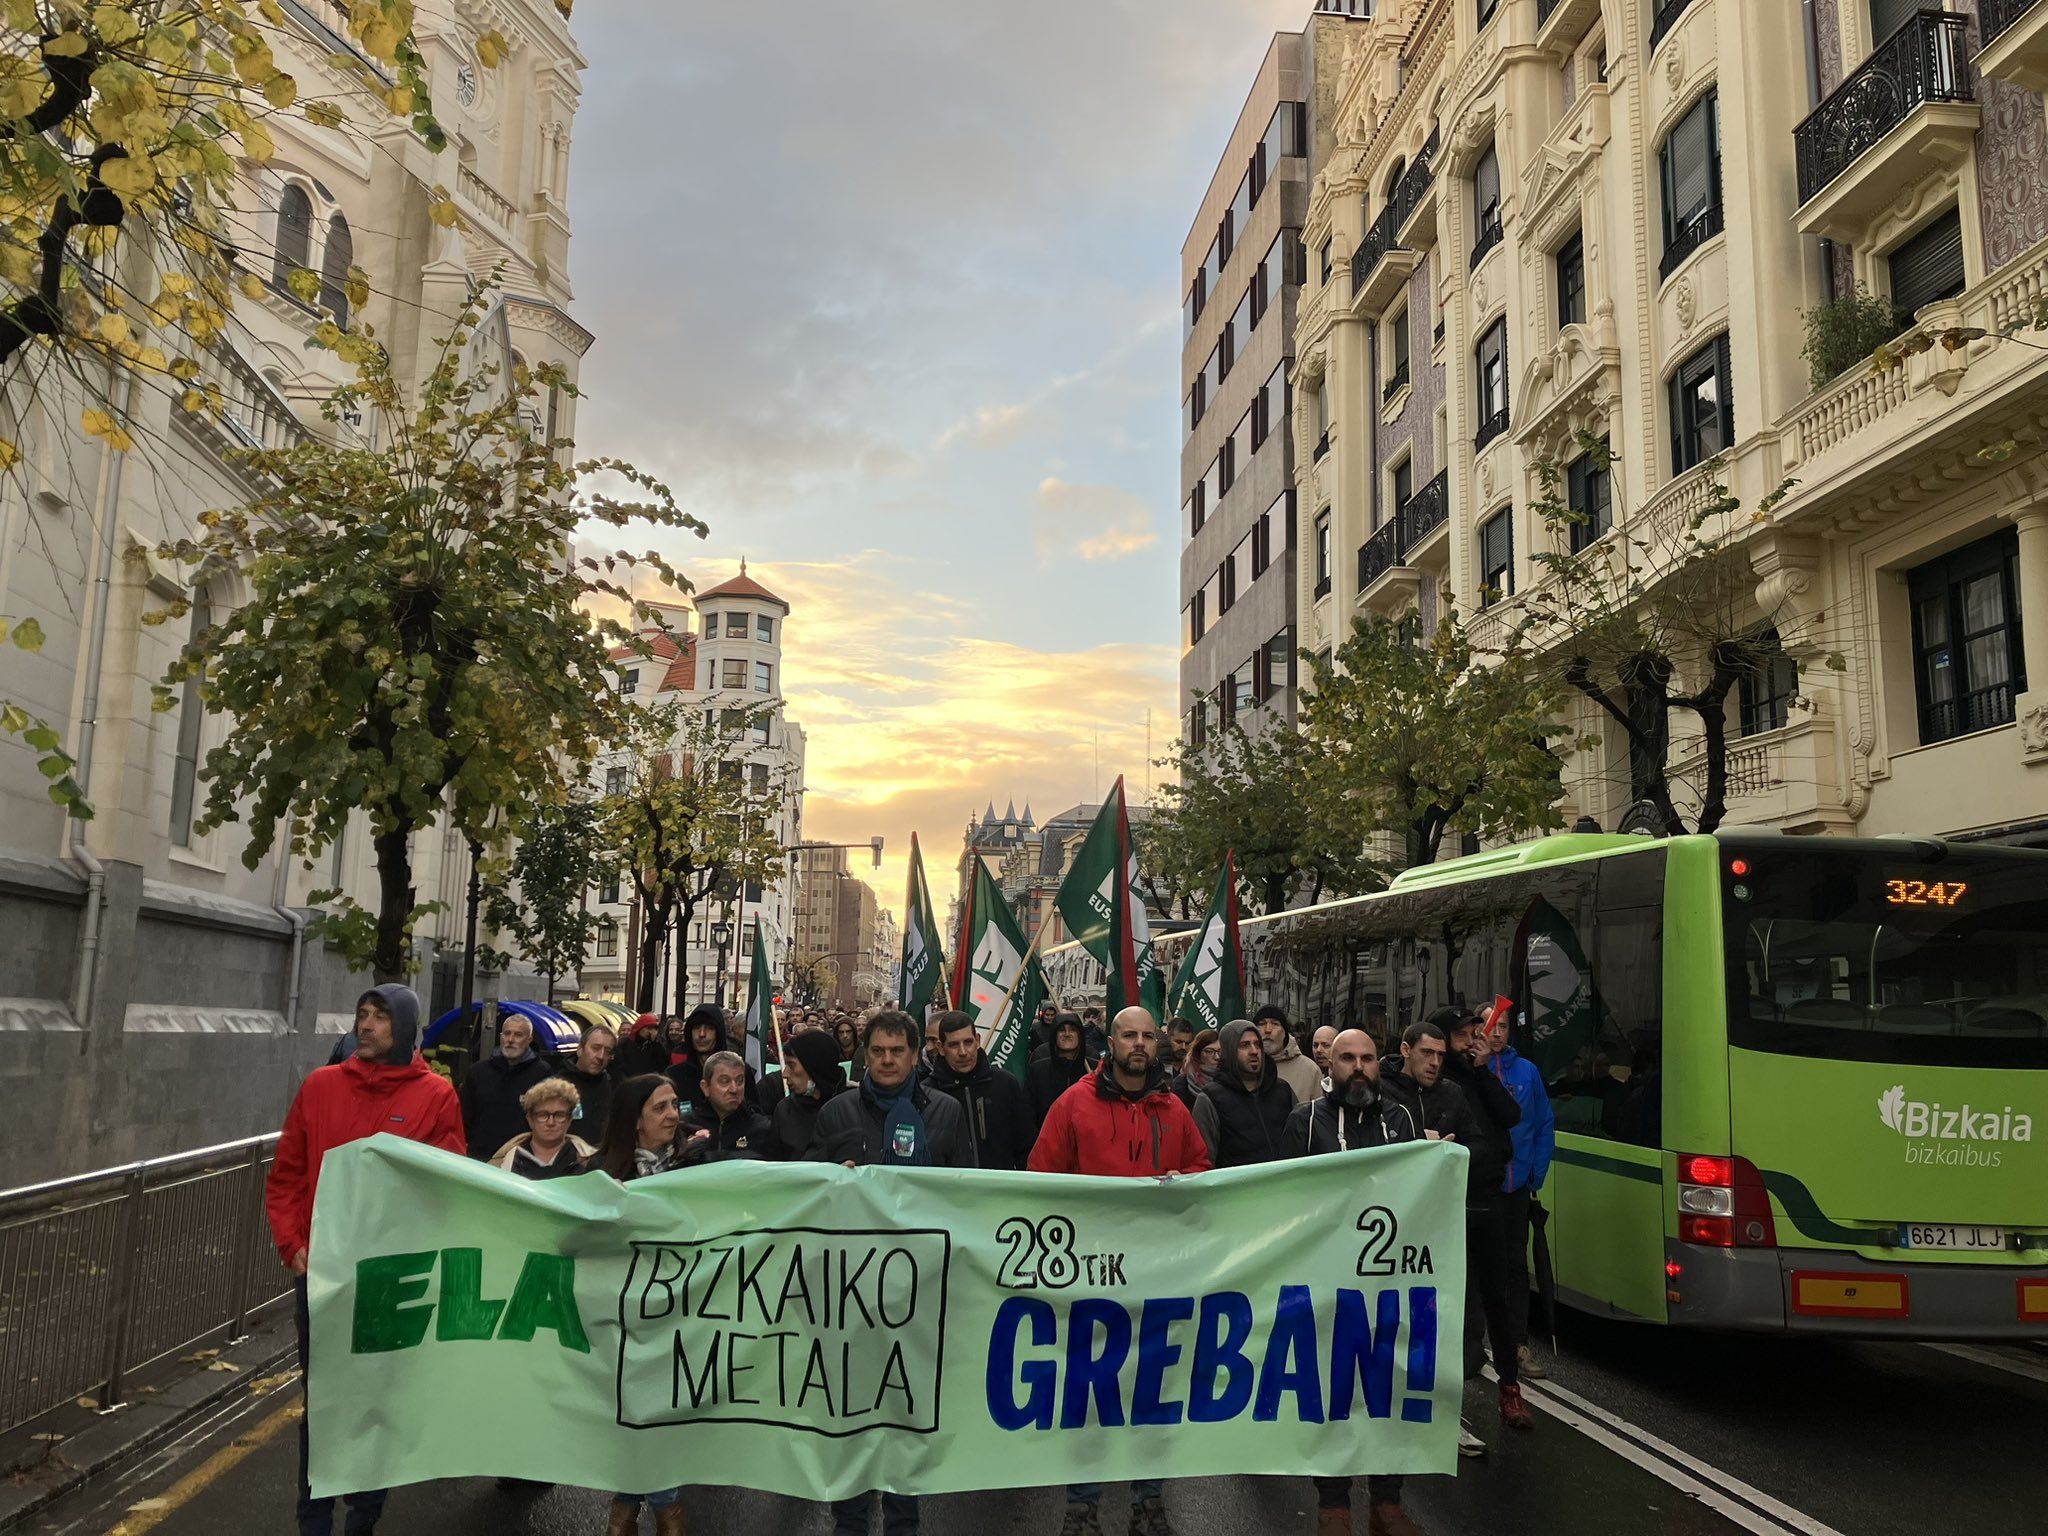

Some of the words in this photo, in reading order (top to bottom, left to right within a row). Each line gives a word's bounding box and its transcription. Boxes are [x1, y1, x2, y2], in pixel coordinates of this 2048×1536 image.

[1087, 893, 1112, 922] EUS
[1885, 880, 1967, 906] 3247
[1196, 998, 1218, 1031] SIND
[1904, 1101, 2033, 1142] Bizkaia
[1904, 1141, 2003, 1169] bizkaibus
[1911, 1227, 1957, 1246] 6621
[1966, 1229, 2000, 1248] JLJ
[351, 1247, 591, 1354] ELA
[639, 1244, 918, 1330] BIZKAIKO
[671, 1330, 914, 1418] METALA
[985, 1284, 1438, 1431] GREBAN!
